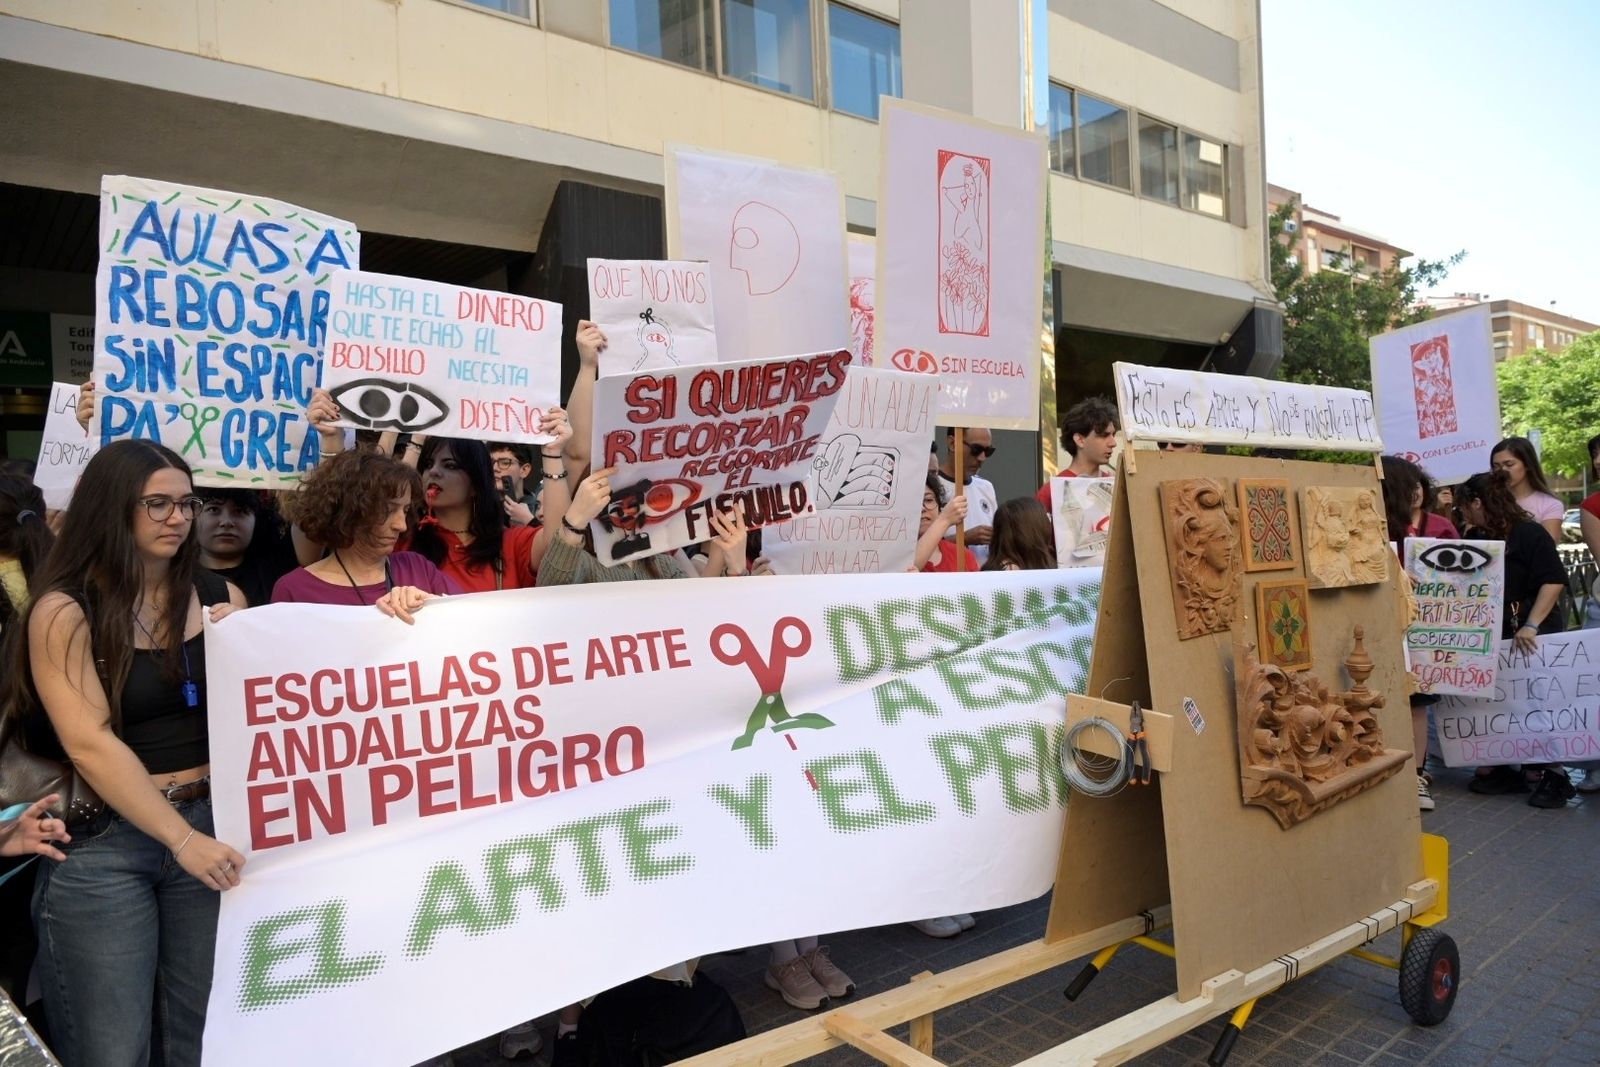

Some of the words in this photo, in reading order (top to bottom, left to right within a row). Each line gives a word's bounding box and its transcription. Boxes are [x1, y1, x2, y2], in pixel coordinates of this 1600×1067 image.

[122, 200, 291, 275] AULAS
[305, 228, 350, 277] A
[594, 264, 633, 299] QUE
[640, 264, 670, 303] NO
[671, 268, 707, 304] NOS
[108, 265, 331, 348] REBOSAR
[346, 280, 415, 314] HASTA
[422, 292, 445, 318] EL
[457, 291, 545, 332] DINERO
[332, 310, 376, 339] QUE
[381, 315, 403, 346] TE
[408, 318, 464, 350] ECHAS
[474, 327, 501, 356] AL
[197, 341, 324, 408] ESPACi
[331, 342, 426, 376] BOLSILLO
[447, 358, 529, 387] NECESITA
[941, 355, 968, 374] SIN
[972, 358, 1026, 379] ESCUELA
[55, 388, 78, 415] LA
[624, 374, 678, 424] SI
[689, 350, 853, 417] QUIERES
[847, 374, 879, 429] UN
[882, 380, 930, 434] AULA
[460, 397, 545, 436] DISEÑO
[1173, 386, 1197, 433] ES
[1246, 394, 1260, 434] Y
[220, 407, 322, 473] CREA
[604, 405, 811, 469] RECORTAR
[1422, 449, 1442, 460] CON
[1444, 440, 1488, 455] ESCUELA
[724, 466, 763, 491] EL
[778, 515, 816, 544] QUE
[817, 516, 846, 542] NO
[846, 514, 909, 543] PAREZCA
[801, 549, 836, 576] UNA
[841, 548, 881, 575] LATA
[1415, 582, 1457, 598] IERRA
[1468, 583, 1489, 598] DE
[1417, 600, 1495, 627] RTISTAS:
[1407, 631, 1480, 648] GOBIERNO
[1434, 649, 1457, 664] DE
[243, 650, 501, 727] ESCUELAS
[512, 641, 574, 690] DE
[584, 627, 692, 681] ARTE
[1411, 663, 1493, 689] ECORTISTAS
[246, 694, 545, 782] ANDALUZAS
[1443, 704, 1588, 741] EDUCACIÓN
[247, 772, 347, 851] EN
[368, 724, 646, 827] PELIGRO
[237, 896, 387, 1016] EL
[400, 797, 696, 961] ARTE
[706, 770, 778, 852] Y
[801, 747, 937, 835] EL
